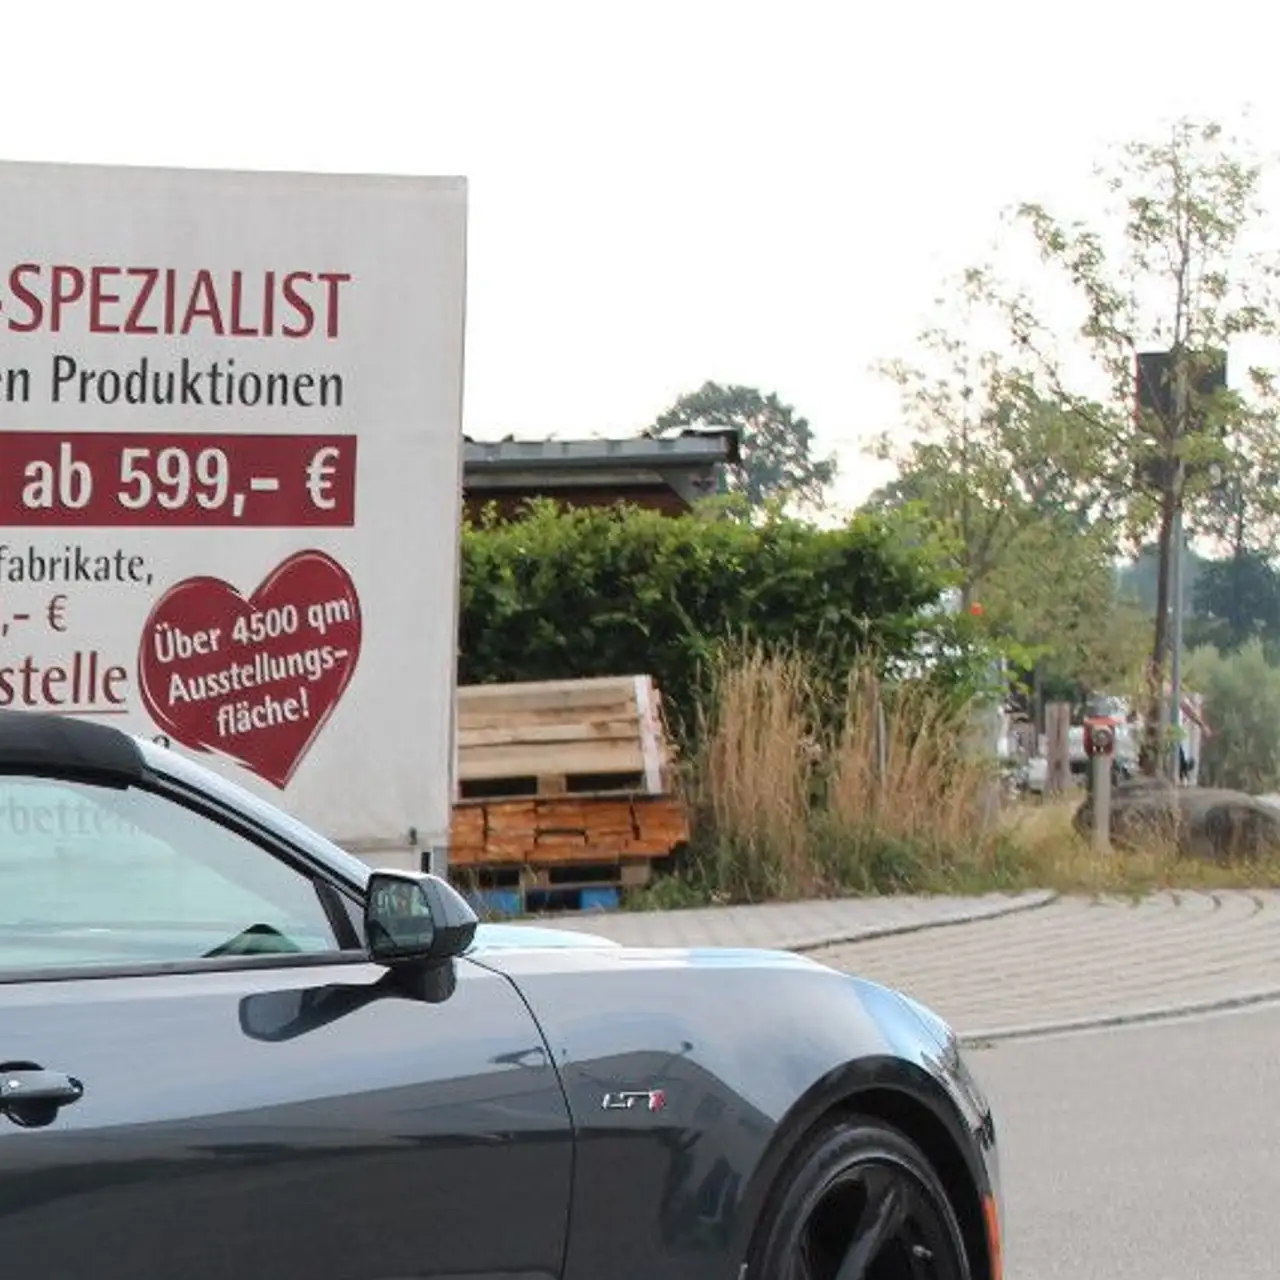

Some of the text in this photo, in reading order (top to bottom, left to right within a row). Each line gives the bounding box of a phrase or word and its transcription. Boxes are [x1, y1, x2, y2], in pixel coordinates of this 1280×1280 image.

[51, 355, 342, 406] Produktionen
[22, 442, 92, 508] ab
[118, 448, 279, 517] 599,-
[305, 447, 339, 509] €
[47, 594, 69, 632] €
[154, 597, 350, 663] Über 4500 qm
[168, 644, 348, 706] Ausstellungs-
[217, 686, 309, 737] fläche!
